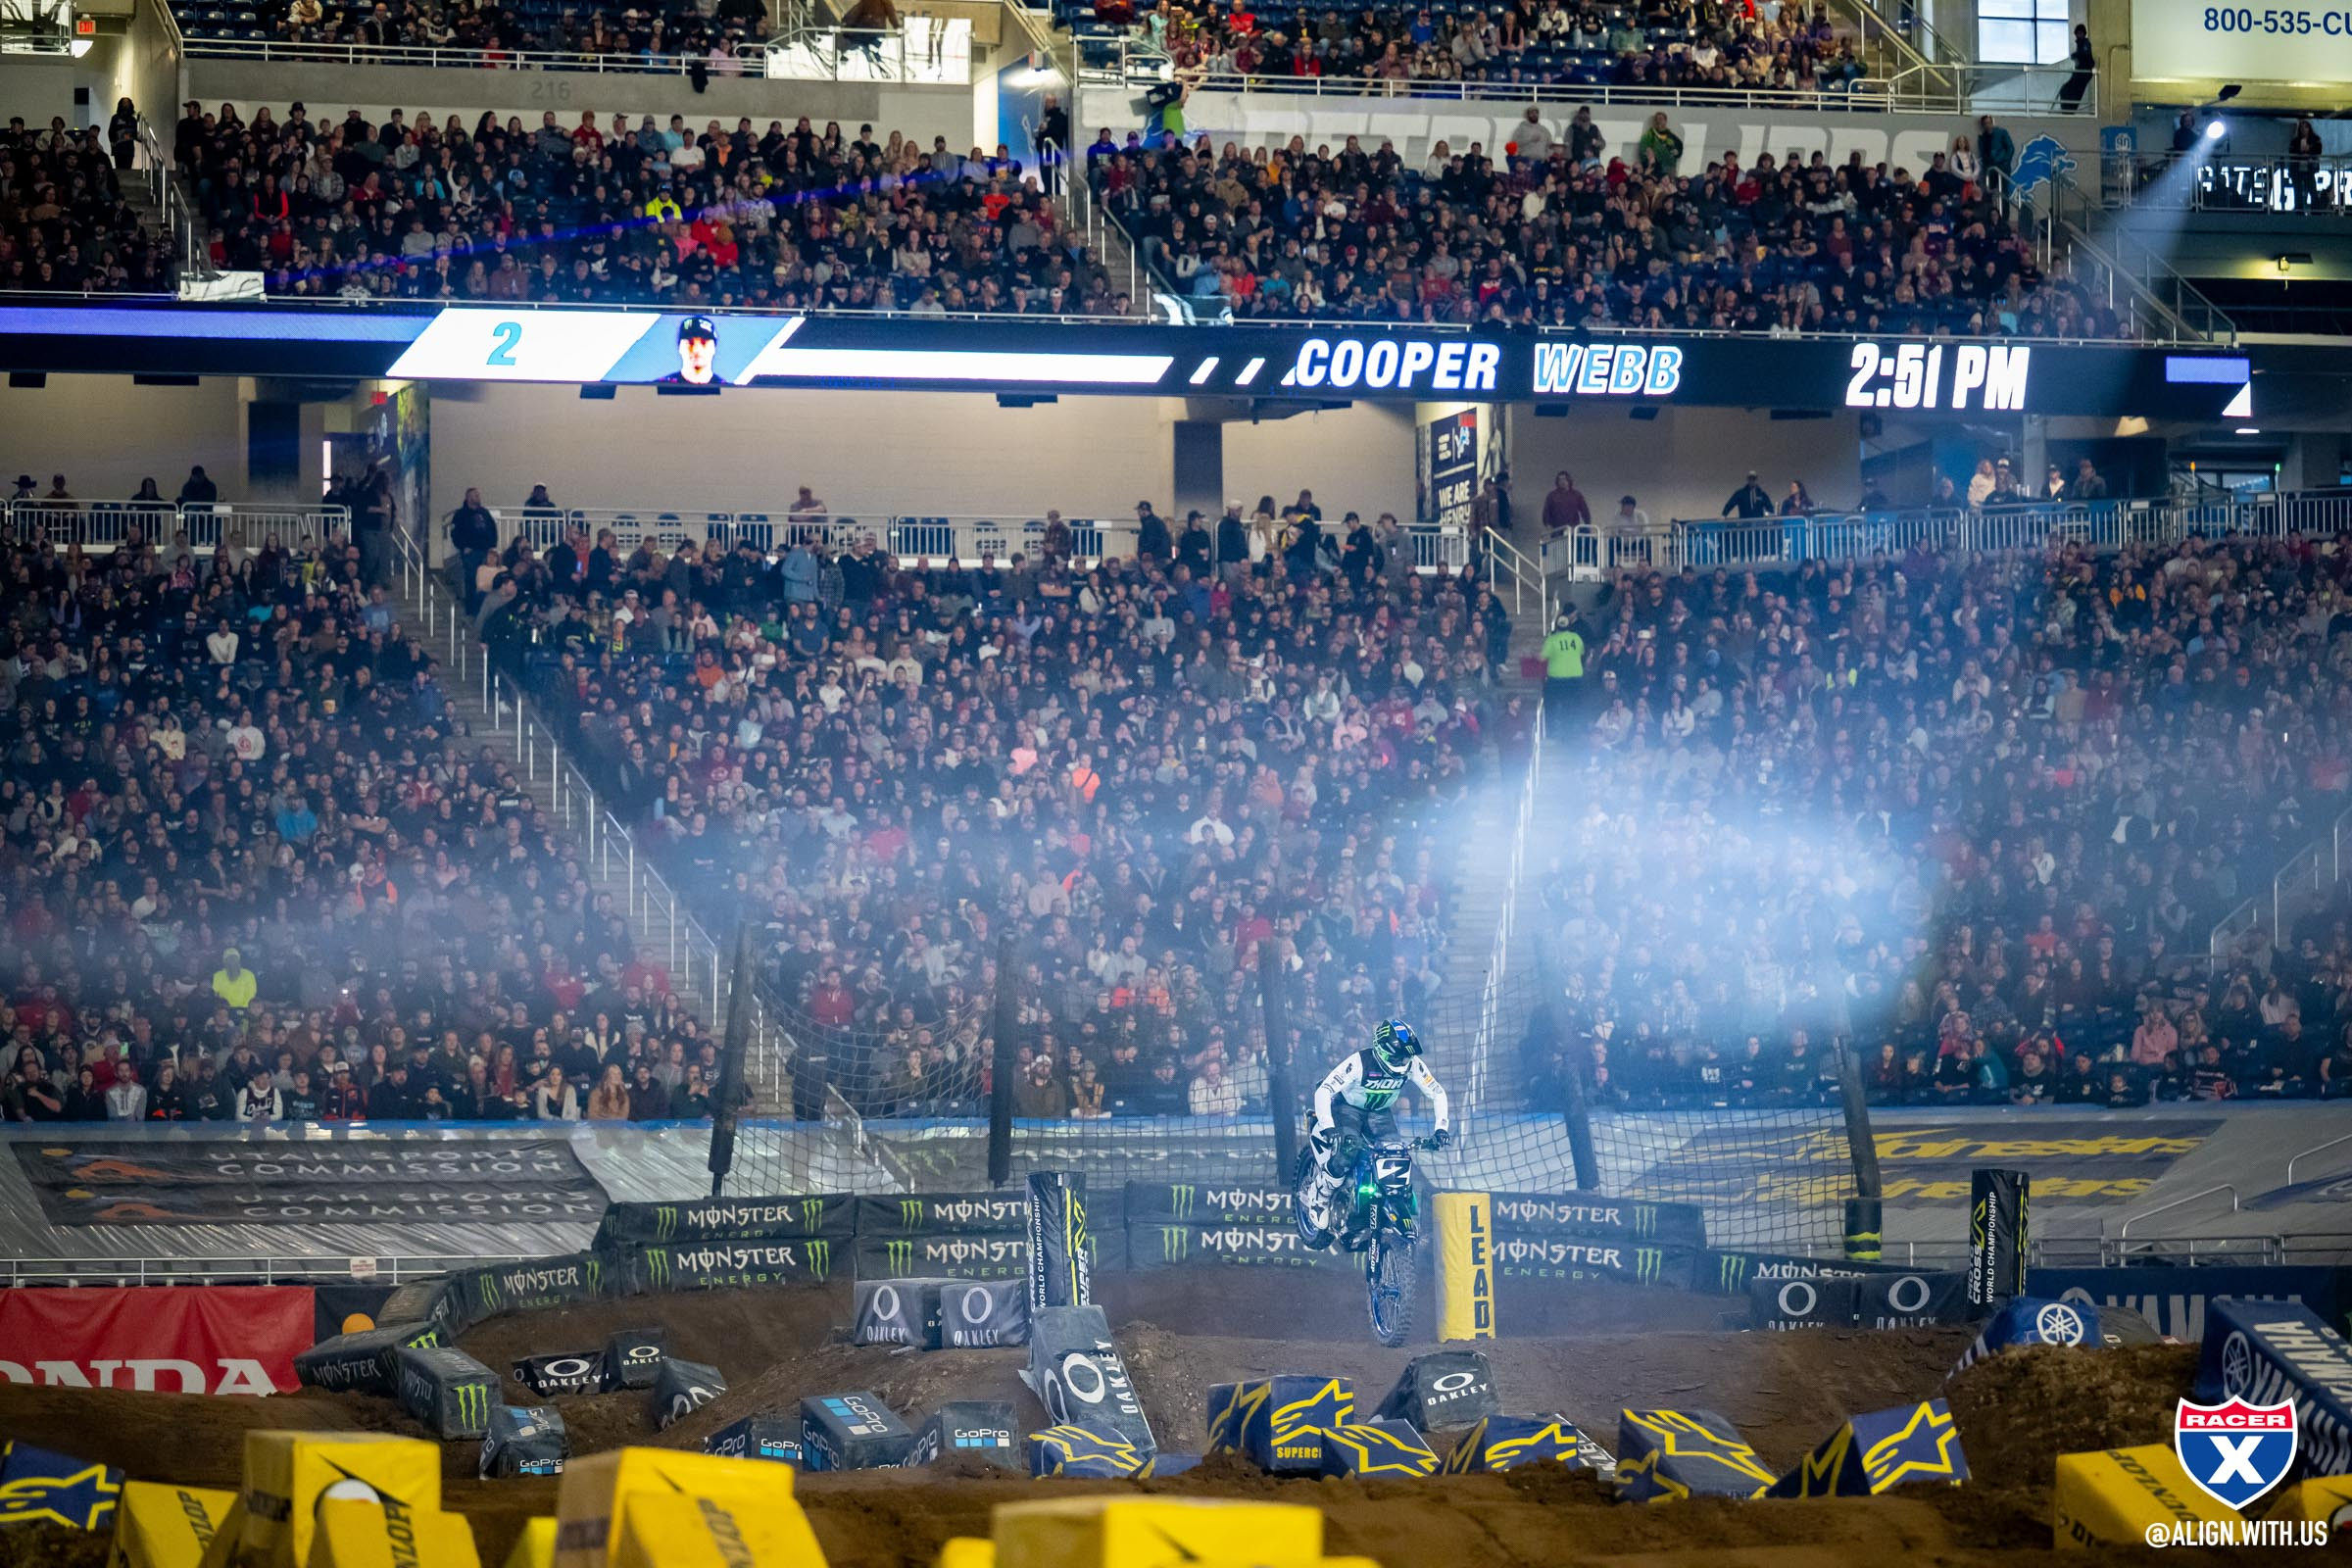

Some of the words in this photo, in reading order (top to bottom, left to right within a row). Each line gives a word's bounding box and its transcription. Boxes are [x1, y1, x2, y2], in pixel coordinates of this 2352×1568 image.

[531, 80, 570, 100] 216
[486, 321, 522, 366] 2
[1295, 339, 1500, 390] COOPER
[1533, 343, 1684, 395] WEBB
[1845, 343, 1942, 409] 2:51
[1952, 345, 2031, 410] PM
[1559, 639, 1577, 651] 114
[209, 1151, 340, 1162] UTAH
[369, 1150, 558, 1162] SPORTS
[217, 1162, 566, 1176] COMMISSION
[233, 1192, 369, 1203] UTAH
[399, 1191, 589, 1203] SPORTS
[242, 1203, 596, 1218] COMMISSION
[688, 1204, 794, 1229] MONSTER
[1497, 1199, 1623, 1226] MONSTER
[1034, 1195, 1044, 1272] CHAMPIONSHIP
[1987, 1191, 1997, 1266] CHAMPIONSHIP
[677, 1246, 797, 1274] MONSTER
[1470, 1205, 1491, 1339] LEAD
[503, 1266, 580, 1297] MONSTER
[699, 1272, 783, 1287] ENERGY
[1504, 1266, 1600, 1280] ENERGY
[1972, 1244, 1983, 1304] CROSS
[518, 1295, 571, 1308] ENERGY
[866, 1325, 908, 1344] OAKLEY
[954, 1329, 1000, 1347] OAKLEY
[313, 1358, 382, 1387] MONSTER
[622, 1355, 668, 1366] OAKLE
[0, 1359, 279, 1397] NDA
[538, 1374, 603, 1389] OAKLEY
[1095, 1340, 1139, 1414] OAKLEY
[1427, 1382, 1489, 1406] OAKLEY
[843, 1396, 889, 1434] GoPro
[802, 1420, 840, 1469] GoPro
[955, 1428, 1010, 1439] GoPro
[519, 1458, 564, 1468] GoPro
[1277, 1446, 1322, 1459] SUPERC
